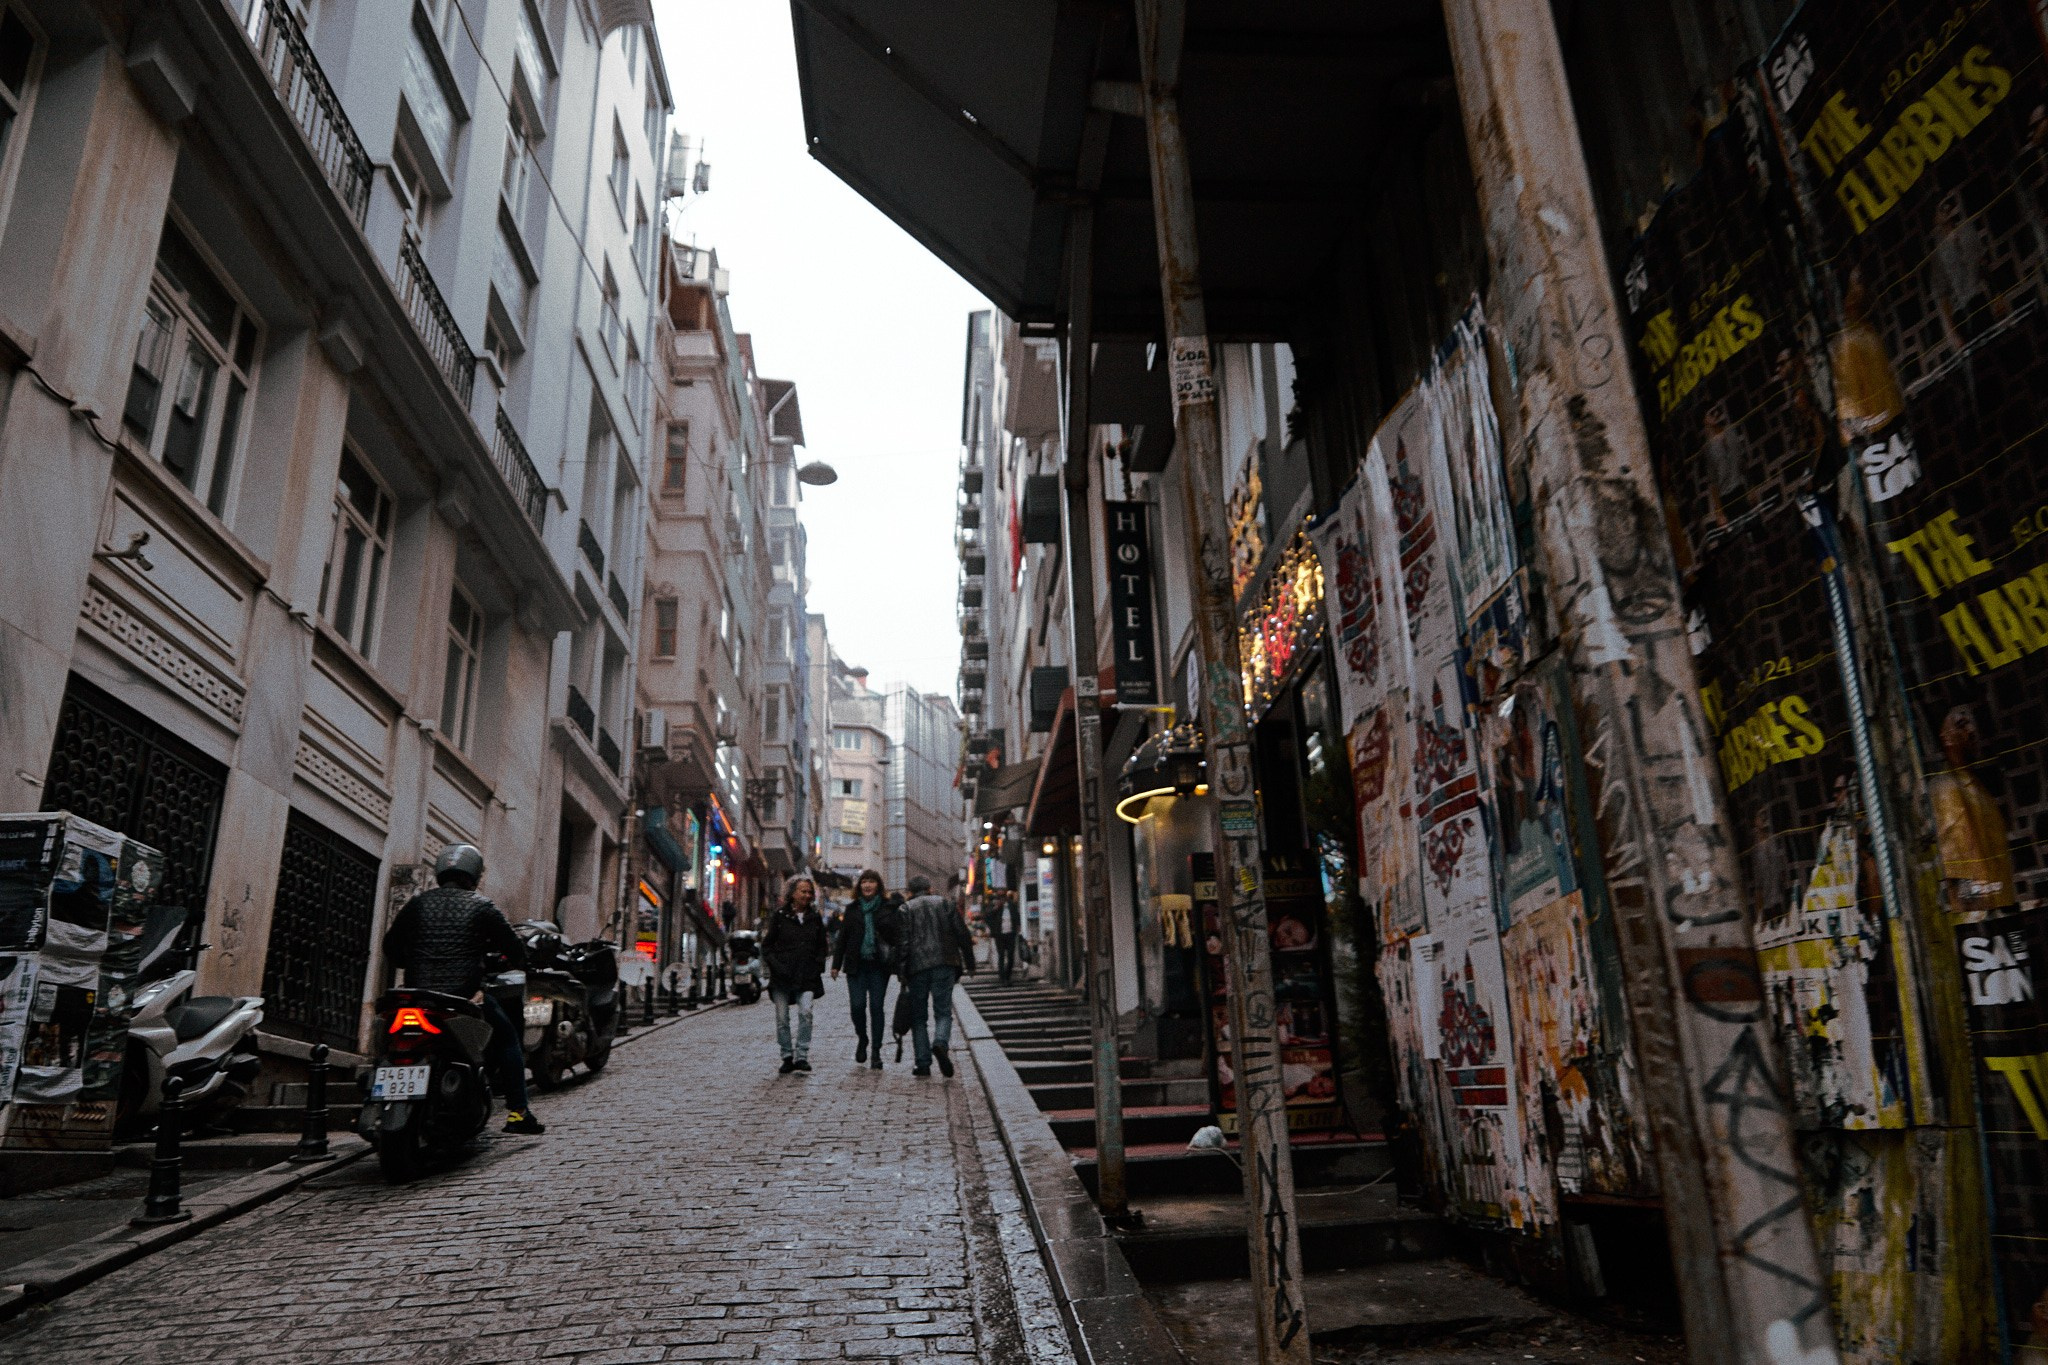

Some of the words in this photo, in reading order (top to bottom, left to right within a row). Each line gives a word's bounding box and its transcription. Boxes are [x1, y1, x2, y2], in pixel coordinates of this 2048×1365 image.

[1800, 89, 1873, 178] THE
[1115, 511, 1144, 662] HOTEL
[1885, 508, 1996, 600] THE
[1967, 968, 2036, 1006] LON
